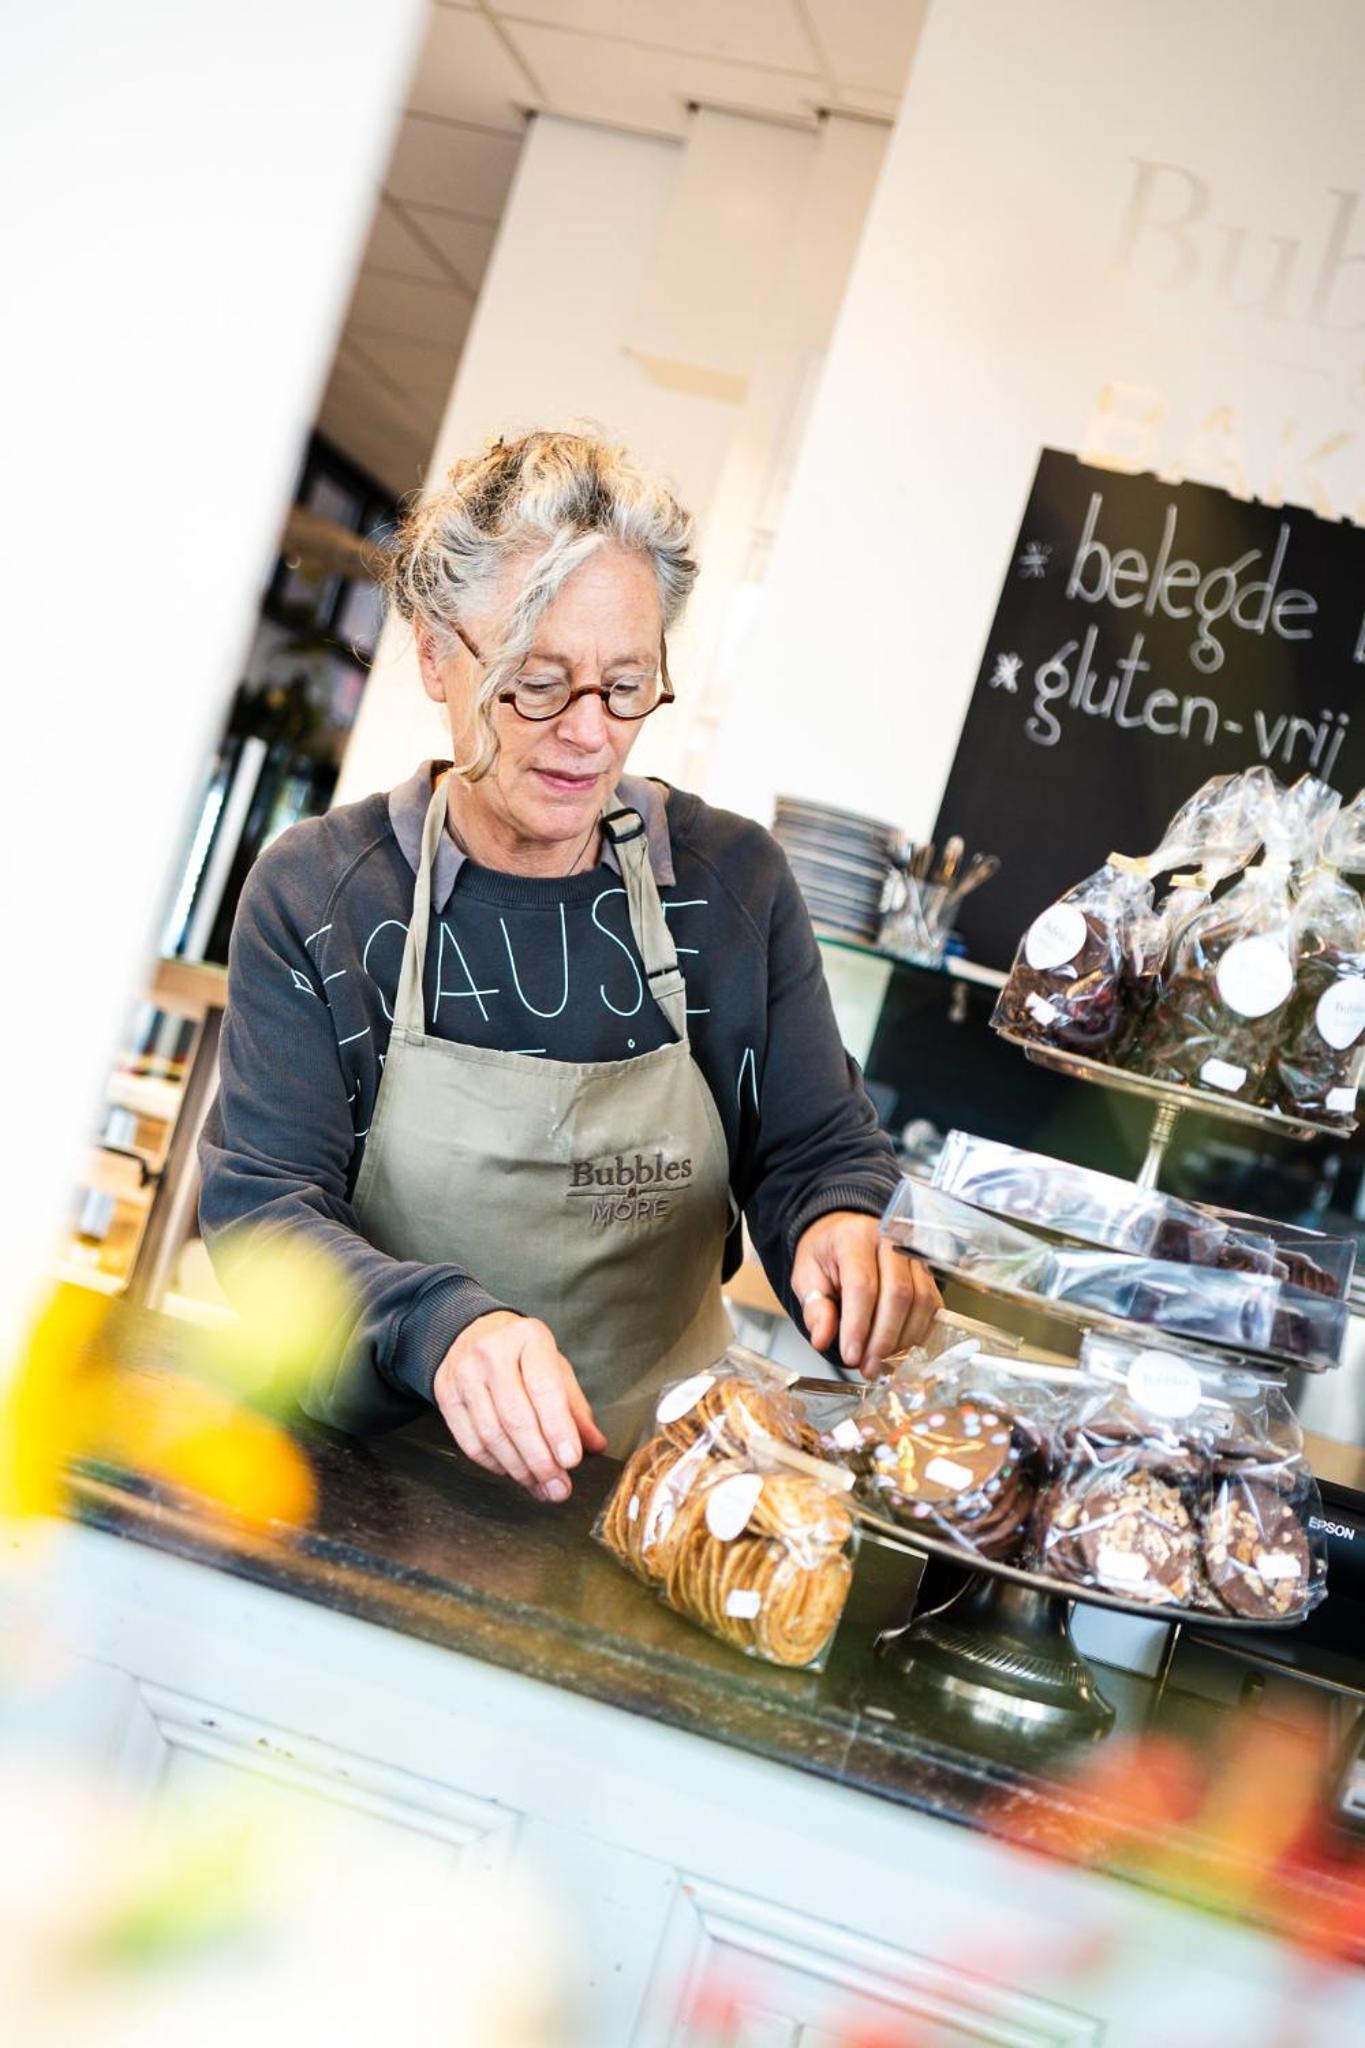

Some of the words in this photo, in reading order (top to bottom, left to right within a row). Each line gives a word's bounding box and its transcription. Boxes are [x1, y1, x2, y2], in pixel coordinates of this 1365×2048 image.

[1065, 491, 1318, 673] belegde
[568, 1152, 693, 1187] Bubbles
[591, 1199, 671, 1223] MORE
[1308, 1515, 1355, 1541] EPSON
